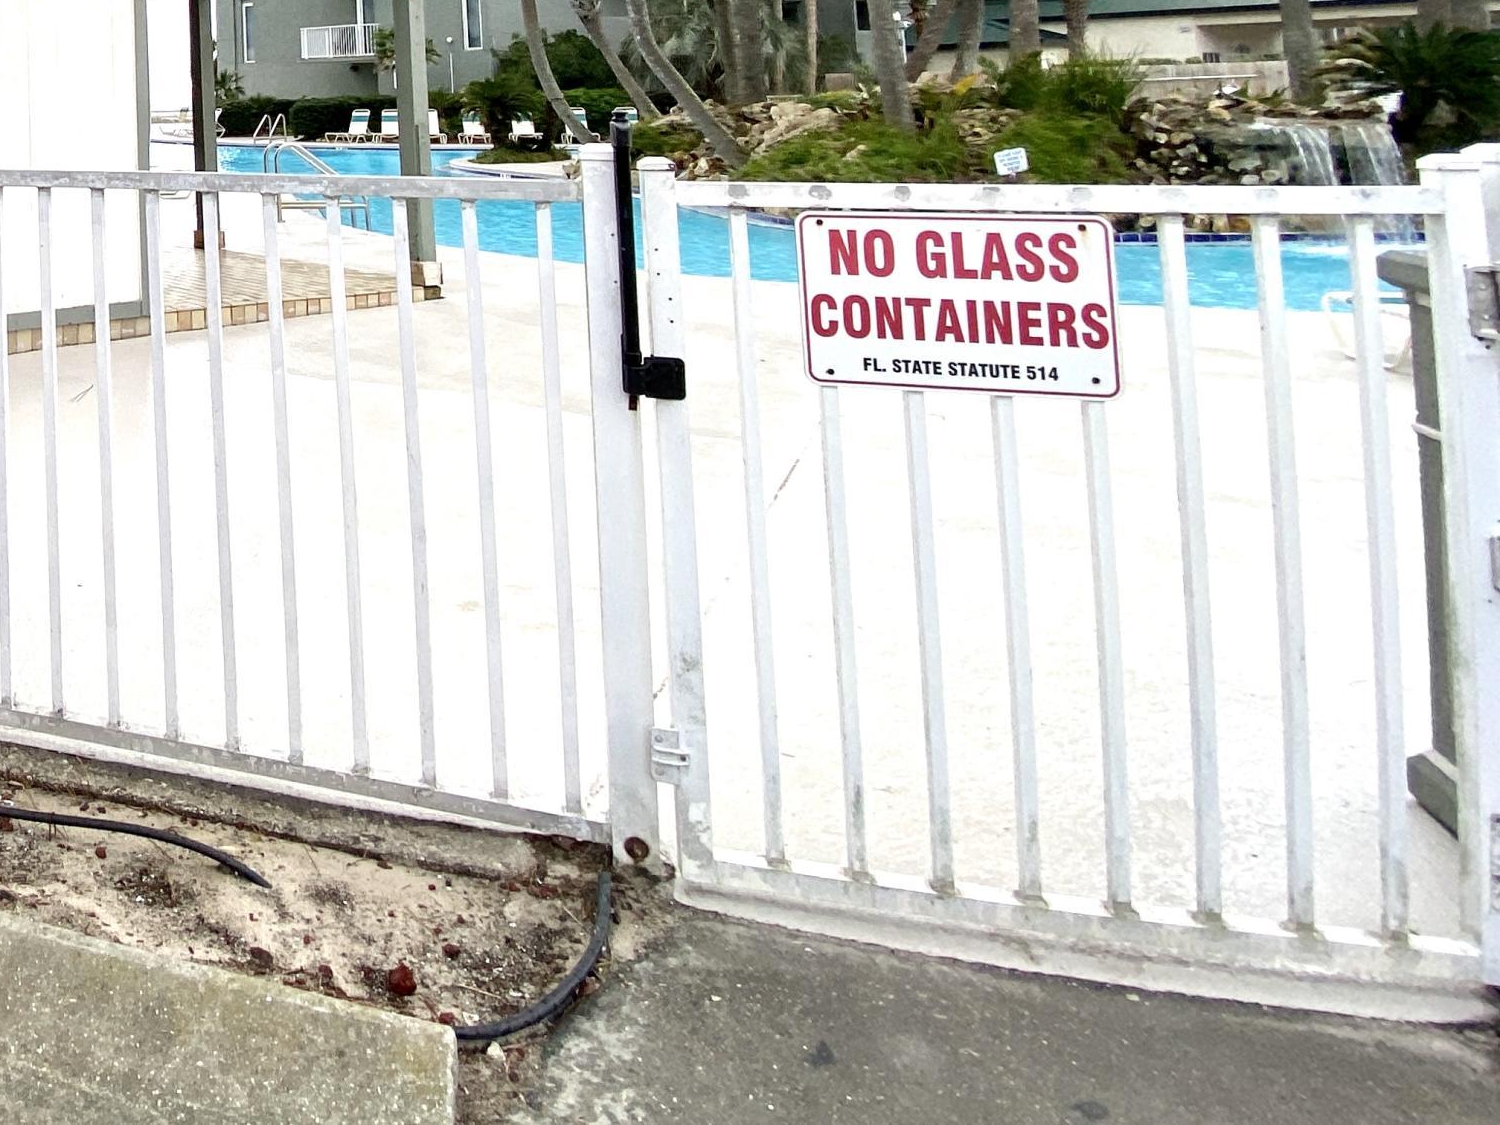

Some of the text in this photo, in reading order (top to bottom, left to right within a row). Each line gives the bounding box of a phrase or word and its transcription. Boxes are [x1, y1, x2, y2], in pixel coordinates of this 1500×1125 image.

[828, 229, 1079, 283] NO GLASS
[811, 293, 1109, 350] CONTAINERS
[863, 357, 1059, 381] FL. STATE STATUTE 514
